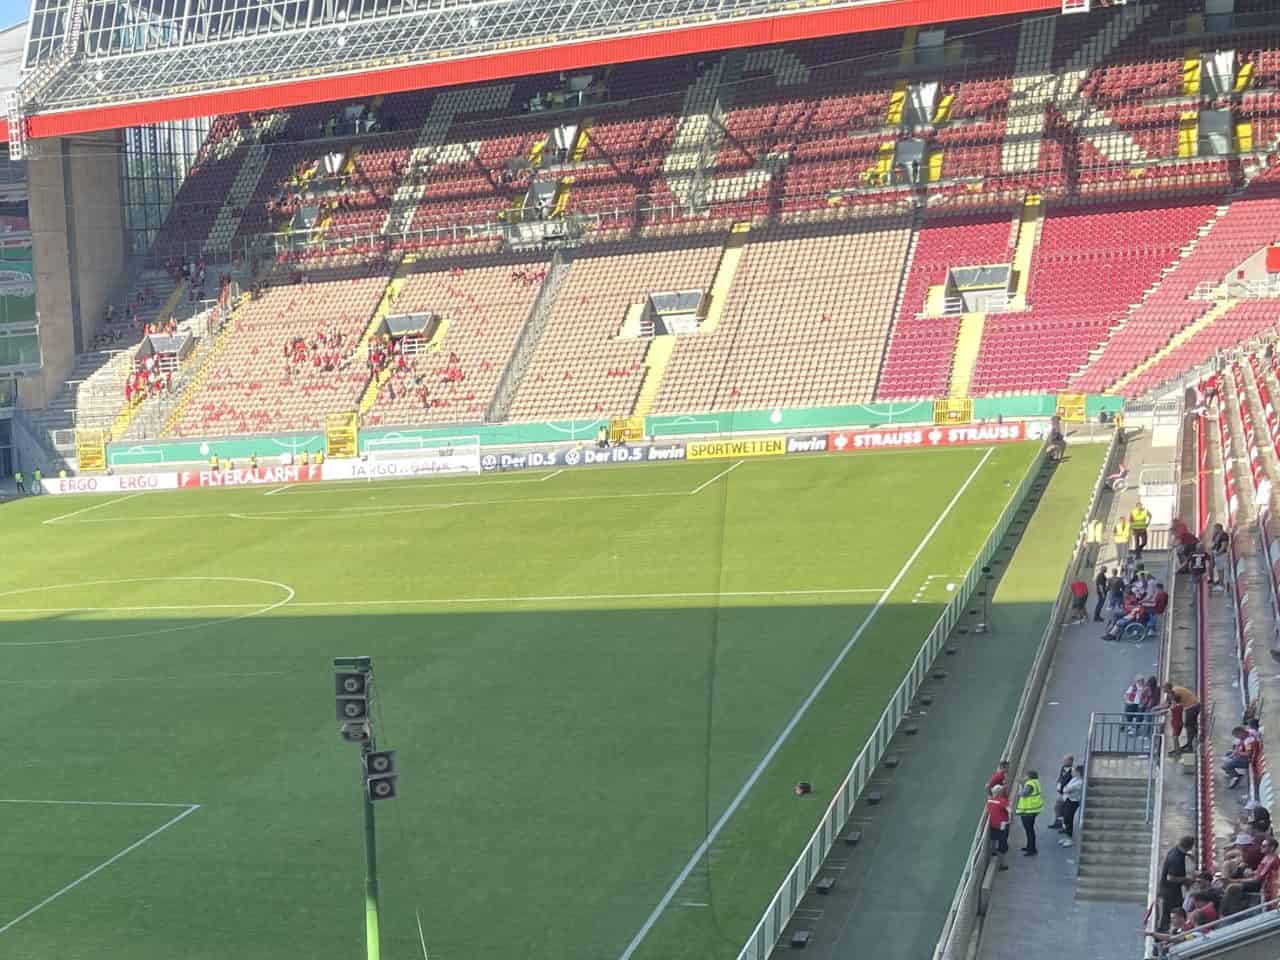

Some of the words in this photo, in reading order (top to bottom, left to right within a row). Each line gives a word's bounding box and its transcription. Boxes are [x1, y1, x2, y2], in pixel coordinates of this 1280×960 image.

[853, 430, 922, 447] STRAUSS
[948, 425, 1019, 442] STRAUSS
[690, 439, 782, 457] SPORTWETTEN
[788, 435, 827, 453] bwin
[501, 455, 525, 467] Der
[528, 452, 556, 465] ID.5
[585, 450, 610, 463] Der
[612, 447, 642, 461] ID.5
[648, 445, 685, 461] bwin
[120, 475, 158, 489] ERGO
[199, 465, 299, 488] FLYERALARM
[60, 478, 98, 492] ERGO
